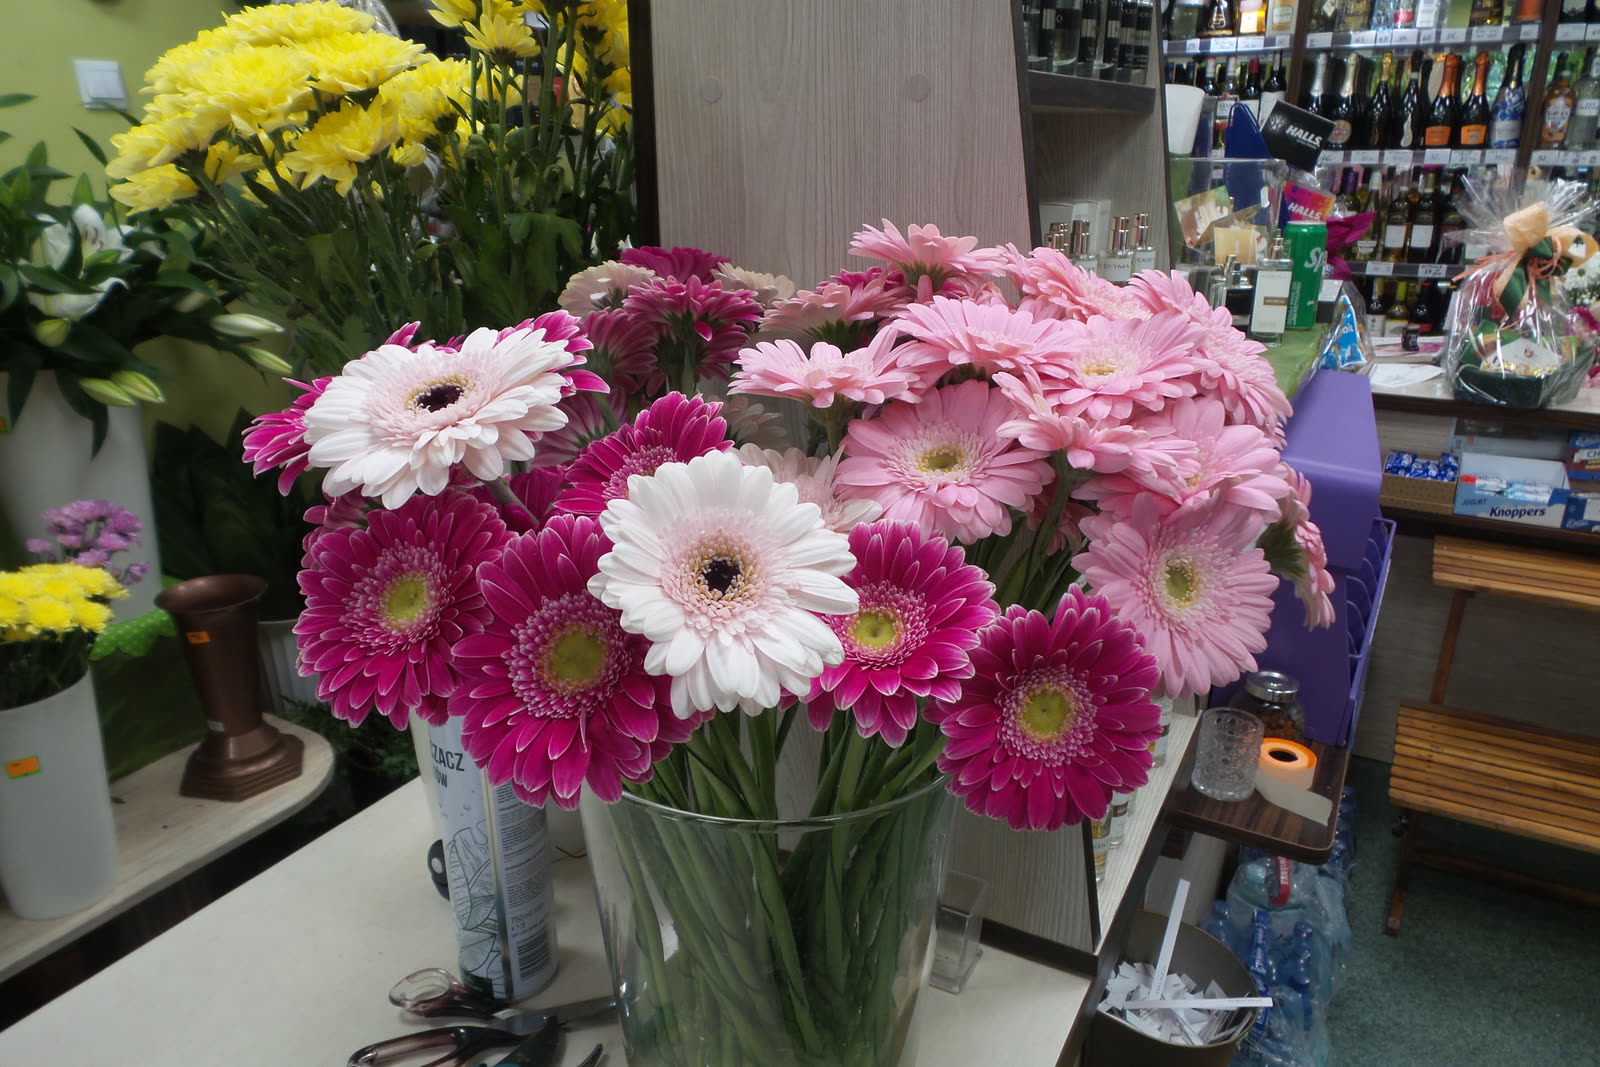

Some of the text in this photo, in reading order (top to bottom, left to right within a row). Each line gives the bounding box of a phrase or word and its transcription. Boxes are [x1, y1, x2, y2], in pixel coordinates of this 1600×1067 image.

[1285, 124, 1322, 147] HALLS
[1287, 202, 1322, 220] HALLS
[1489, 505, 1546, 519] Knoppers
